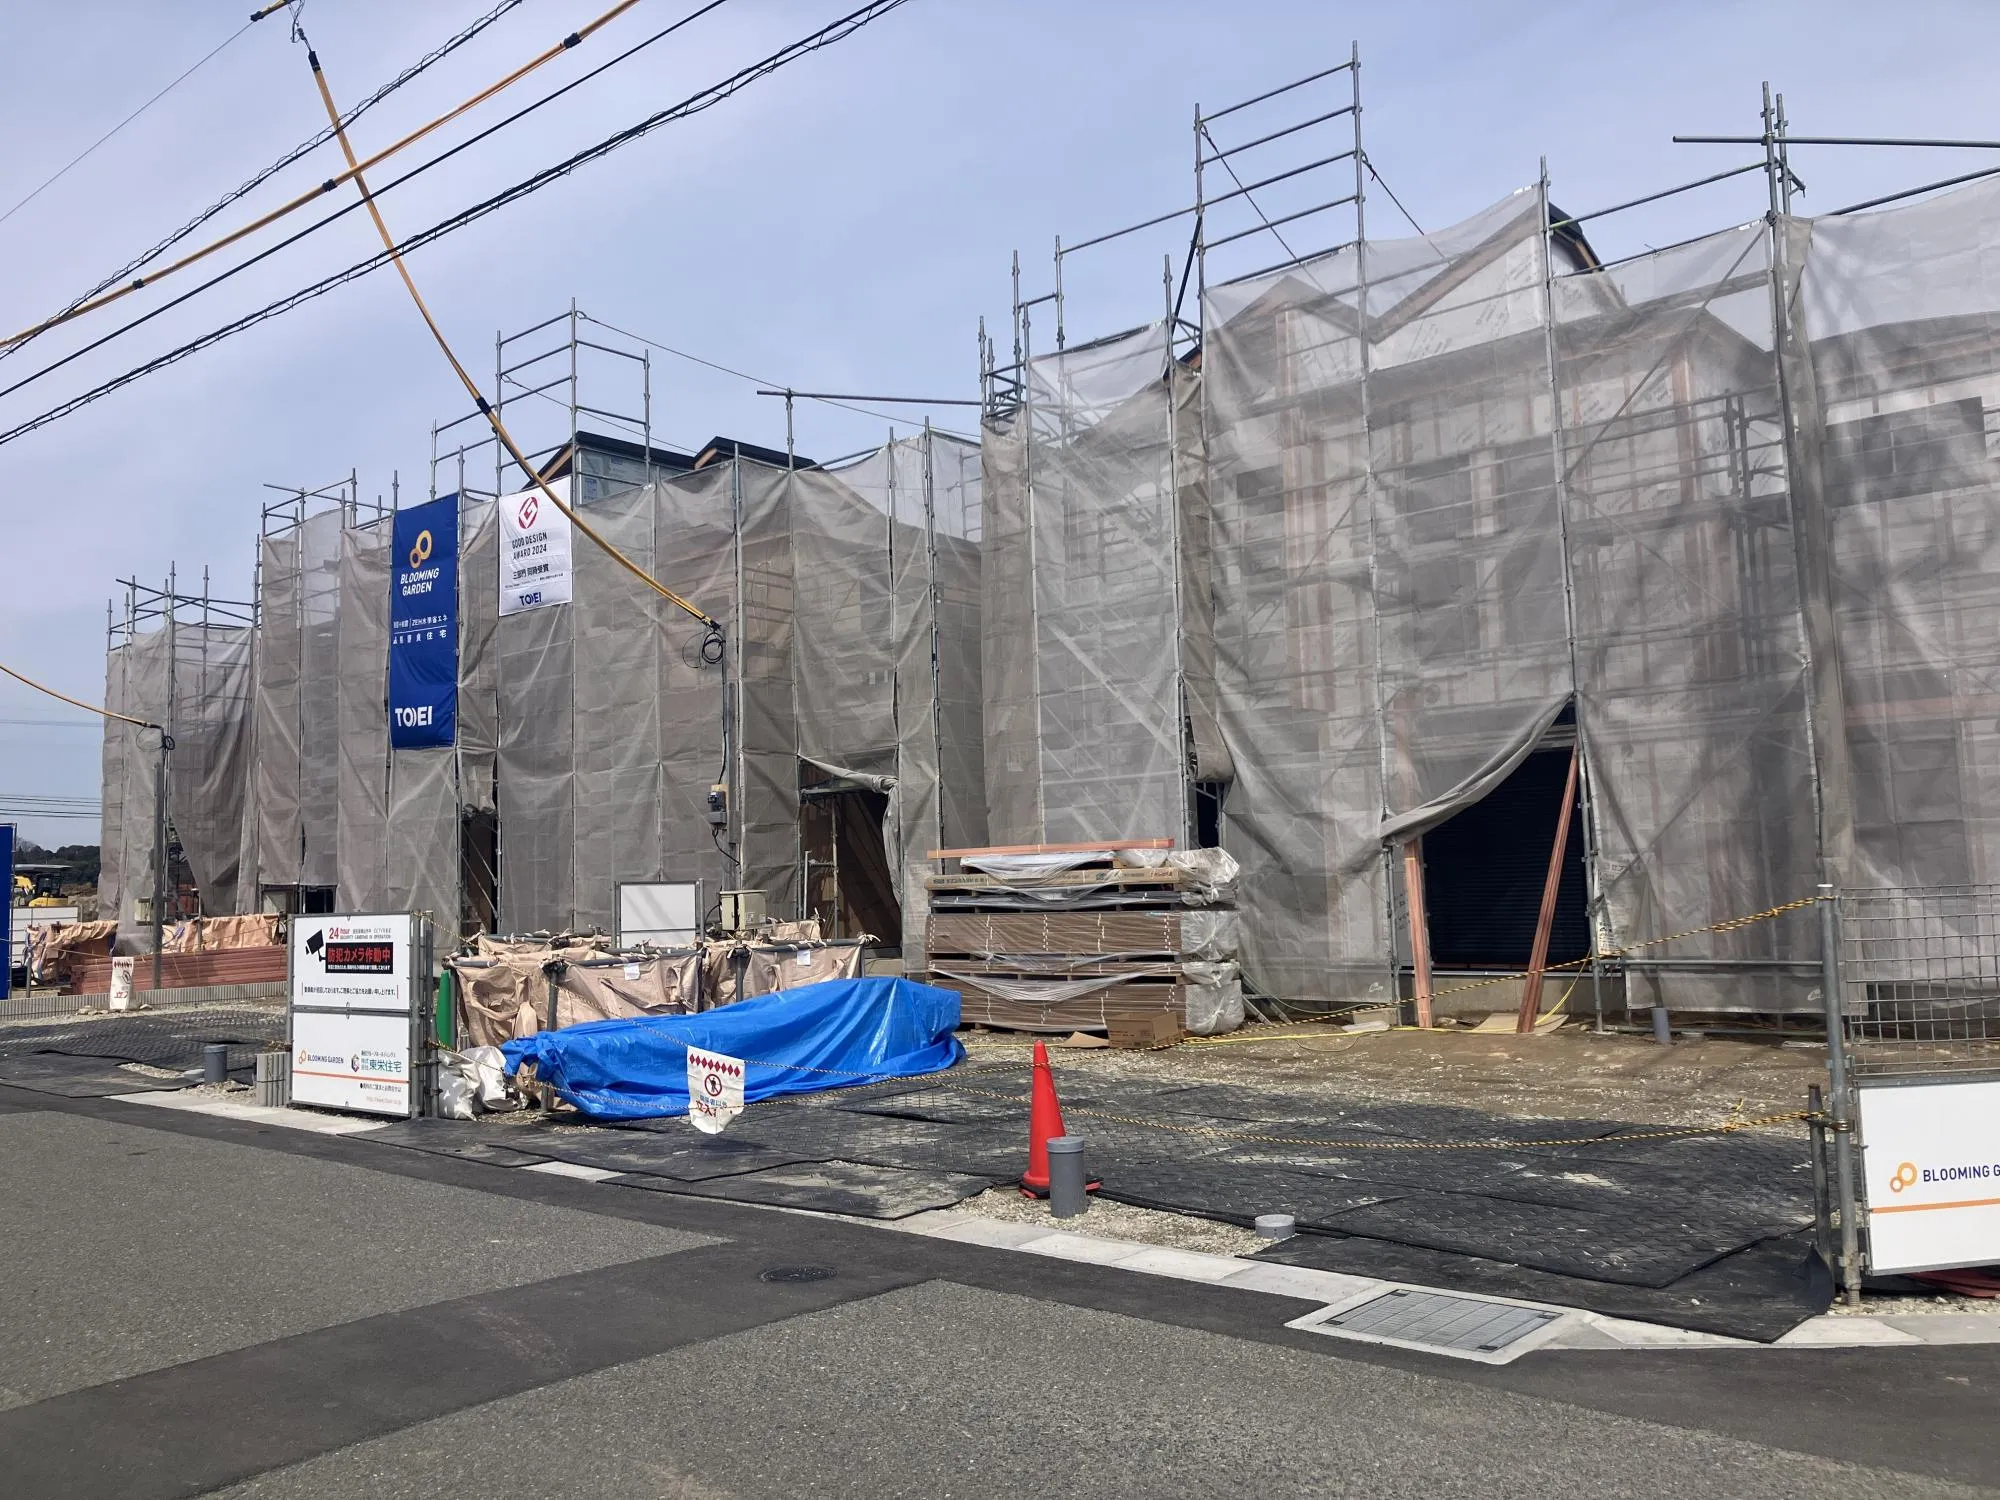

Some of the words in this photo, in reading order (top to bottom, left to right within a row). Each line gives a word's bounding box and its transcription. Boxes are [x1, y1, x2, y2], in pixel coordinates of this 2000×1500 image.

[511, 537, 525, 549] GOOD
[525, 532, 548, 546] DESIGN
[513, 547, 531, 560] AWARD
[532, 543, 547, 555] 2024
[400, 567, 440, 585] BLOOMING
[402, 581, 432, 597] GARDEN
[519, 592, 542, 606] TOEI
[394, 705, 433, 728] TOEI
[328, 927, 339, 940] 24
[327, 947, 391, 963] 防犯カメラ作動中
[307, 1054, 328, 1063] BLOOMING
[328, 1055, 344, 1064] GARDEN
[369, 1059, 402, 1073] 東栄住宅
[1923, 1165, 1990, 1182] BLOOMING
